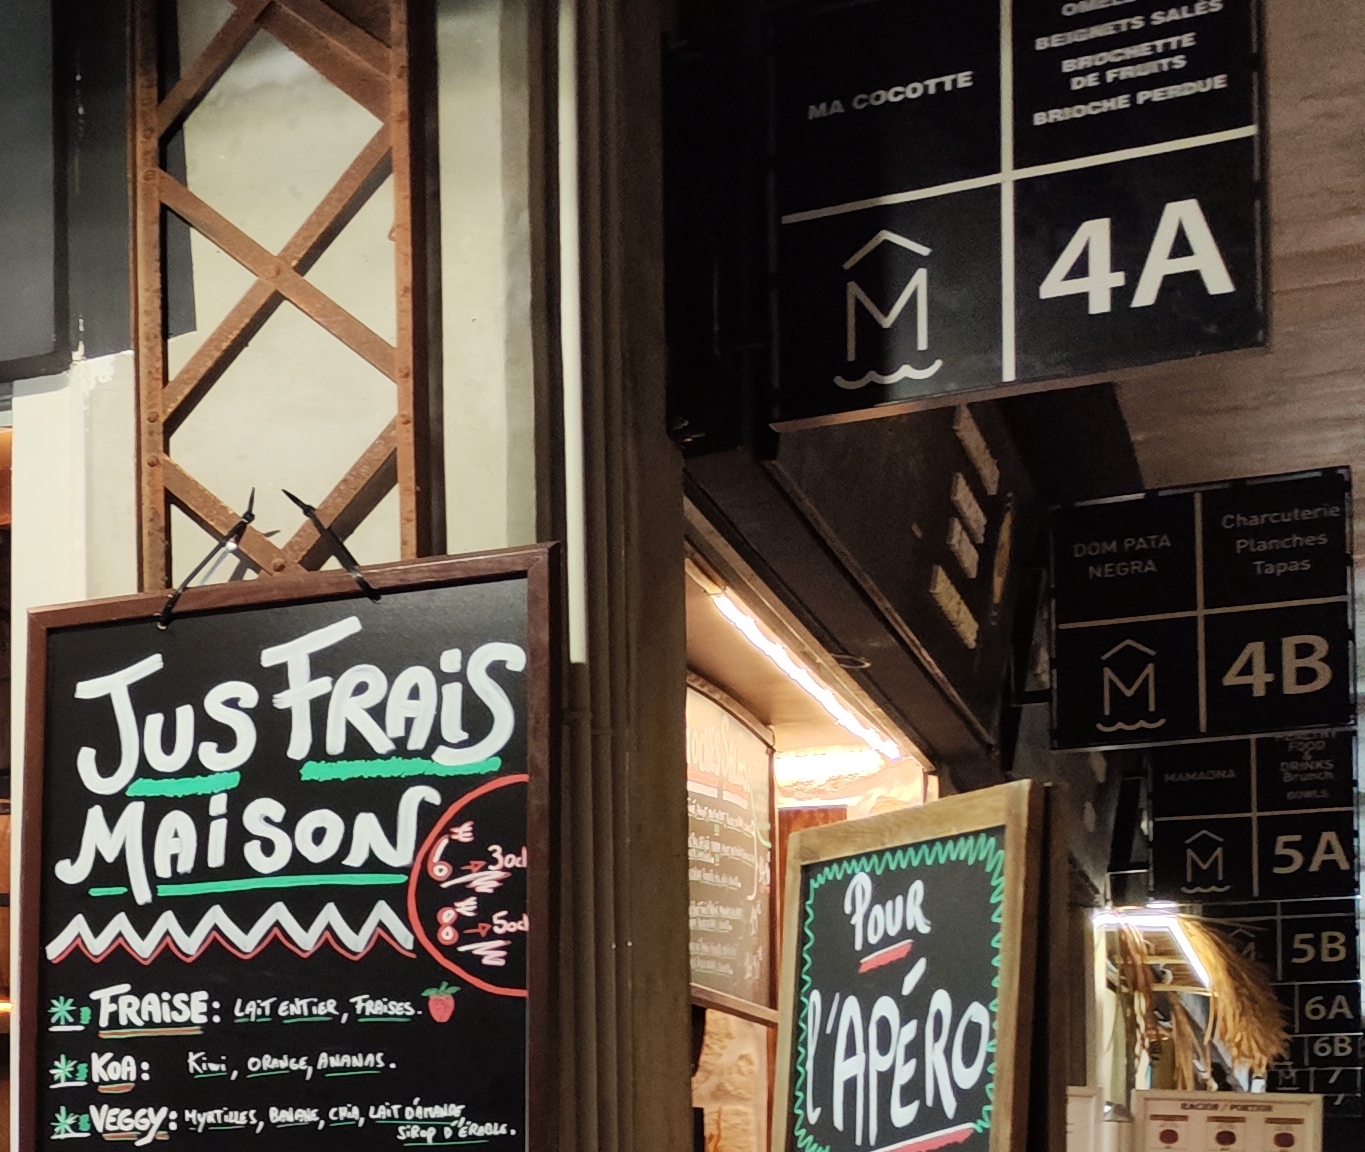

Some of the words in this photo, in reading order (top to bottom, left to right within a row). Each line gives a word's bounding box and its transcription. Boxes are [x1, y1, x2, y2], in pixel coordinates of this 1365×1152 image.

[1035, 16, 1146, 50] BEIGNETS
[1061, 32, 1197, 73] BROCHETTE
[1071, 72, 1100, 90] DE
[1105, 55, 1187, 83] FRUITS
[807, 99, 846, 120] MA
[852, 71, 975, 109] COCOTTE
[1033, 94, 1131, 126] BRIOCHE
[1136, 74, 1228, 105] PERDUE
[1038, 197, 1236, 316] 4A
[1221, 504, 1340, 530] Charcuterie
[1073, 540, 1117, 558] DOM
[1124, 534, 1171, 552] PATA
[1236, 533, 1329, 553] Planches
[1088, 560, 1157, 580] NEGRA
[1252, 559, 1312, 577] Tapas
[1222, 634, 1333, 698] 4B
[74, 652, 260, 797] JUS
[260, 615, 527, 766] FRAIS
[54, 785, 443, 906] MAISON
[1272, 831, 1350, 874] 5A
[844, 871, 931, 951] POUR
[1291, 931, 1347, 964] 5B
[233, 995, 273, 1019] LAIT
[1305, 995, 1354, 1021] 6A
[1313, 1036, 1353, 1057] 6B
[369, 1103, 401, 1121] LAIT
